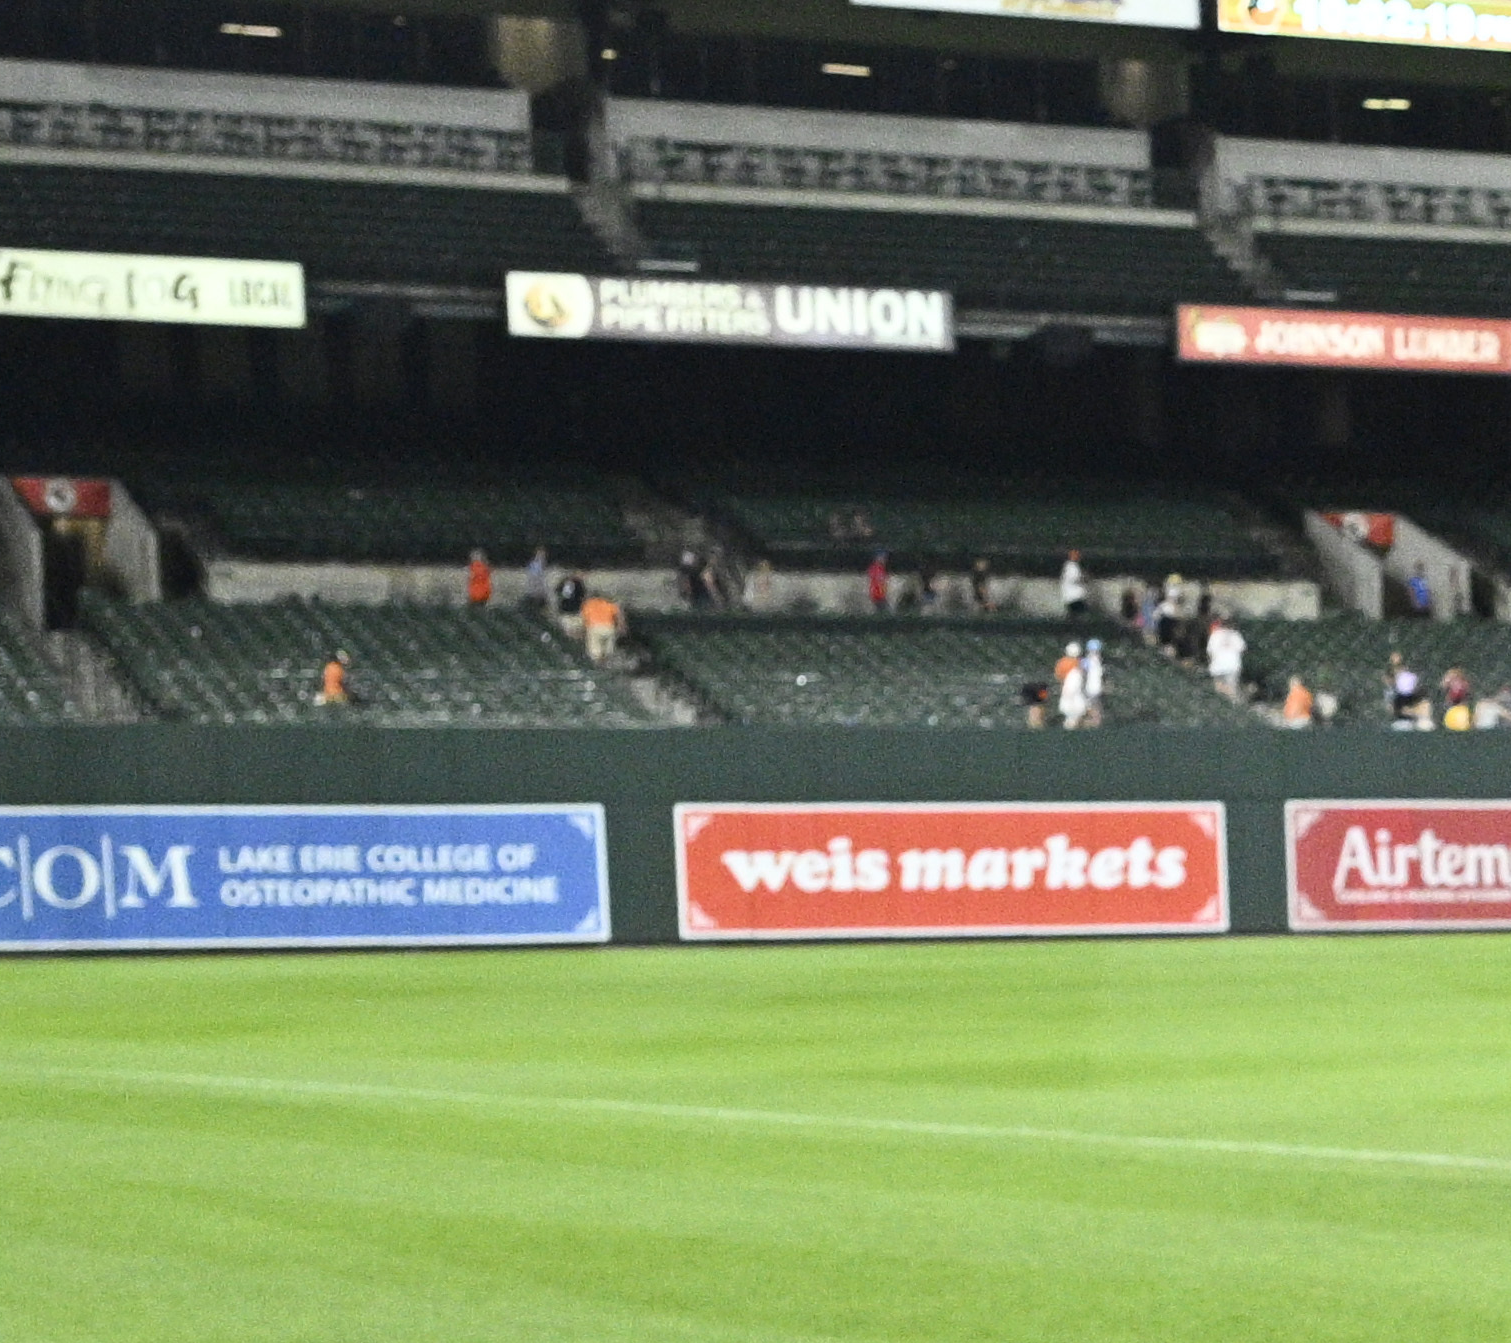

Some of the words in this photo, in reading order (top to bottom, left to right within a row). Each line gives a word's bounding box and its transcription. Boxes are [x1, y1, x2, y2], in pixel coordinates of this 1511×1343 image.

[775, 285, 945, 342] UNION
[218, 844, 293, 873] LAKE
[299, 845, 361, 873] ERIE
[366, 843, 489, 873] COLLEGE
[496, 843, 536, 872] OF
[721, 835, 890, 893] weis
[898, 833, 1188, 892] markets
[220, 878, 419, 907] OSTEOPATHIC
[422, 875, 560, 905] MEDICINE
